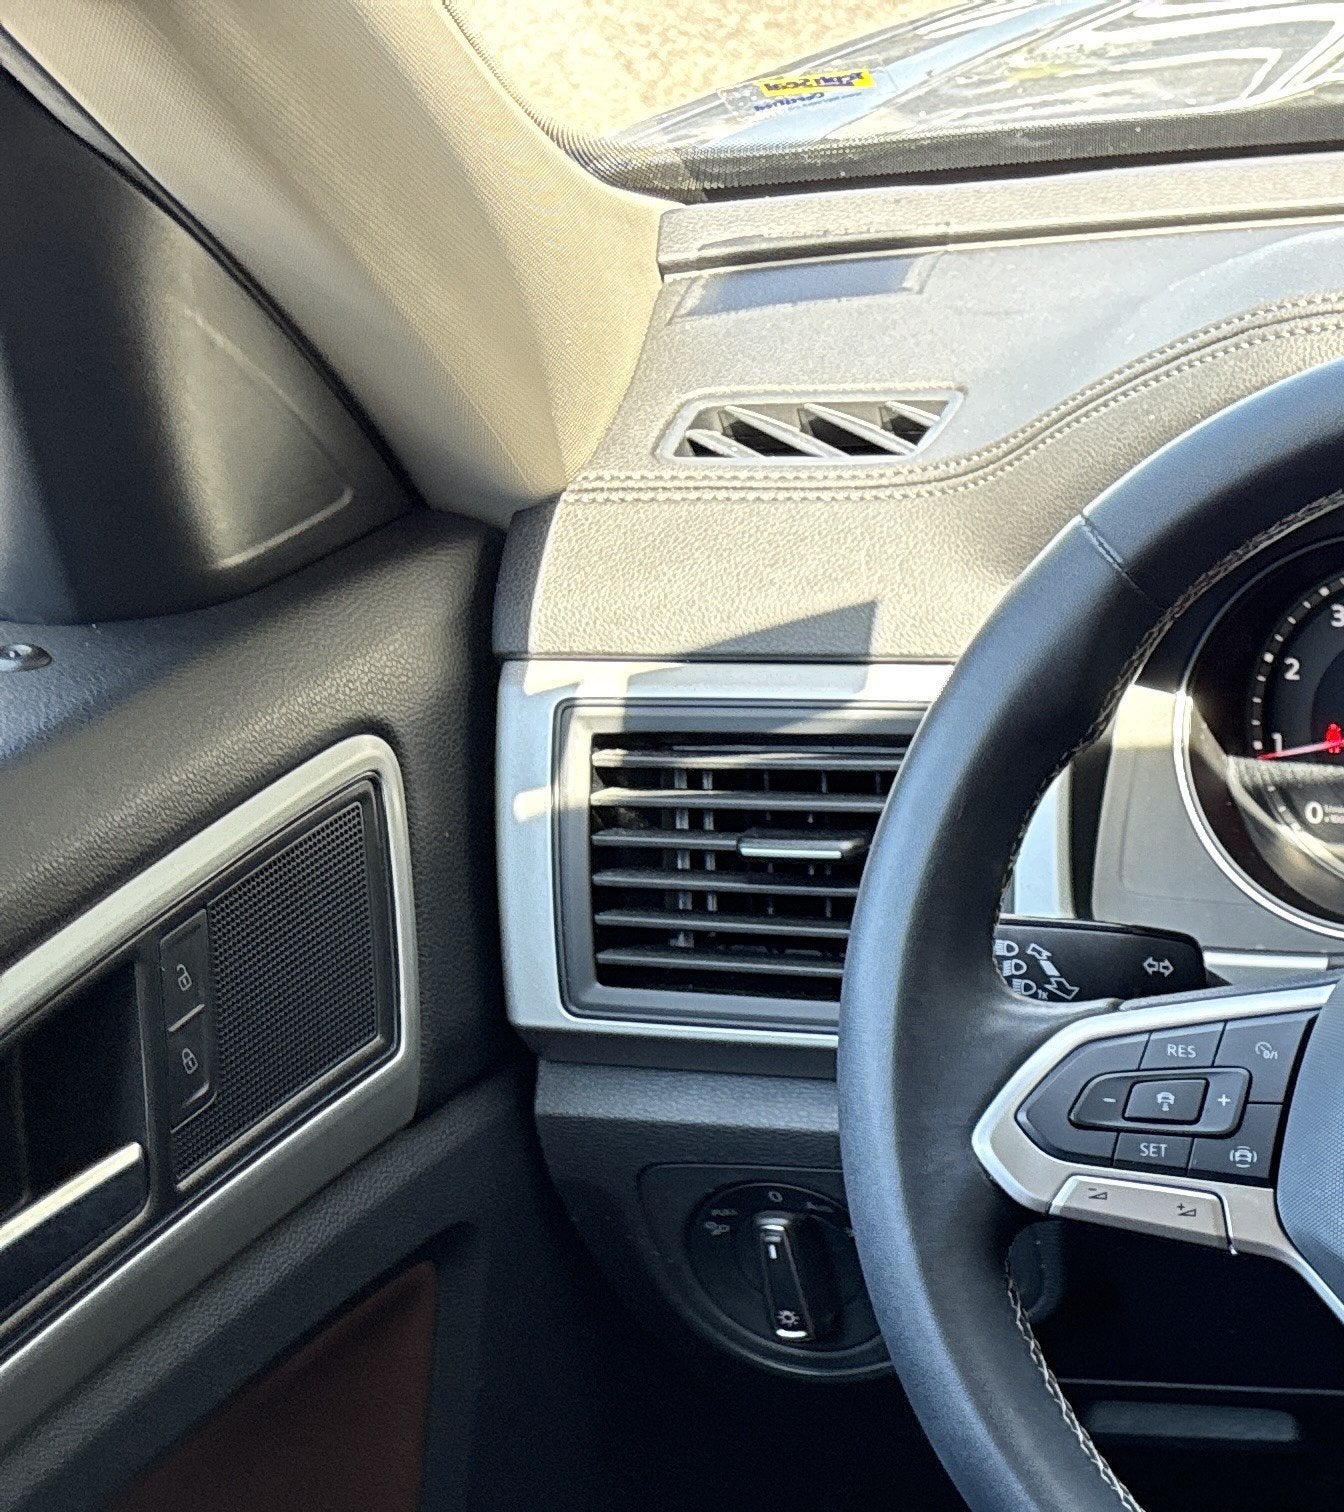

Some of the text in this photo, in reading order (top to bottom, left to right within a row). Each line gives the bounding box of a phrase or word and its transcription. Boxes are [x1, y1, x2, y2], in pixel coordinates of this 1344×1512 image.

[1284, 657, 1300, 680] 2
[1304, 801, 1323, 824] 0
[1167, 1043, 1196, 1059] RES
[1139, 1142, 1168, 1158] SET
